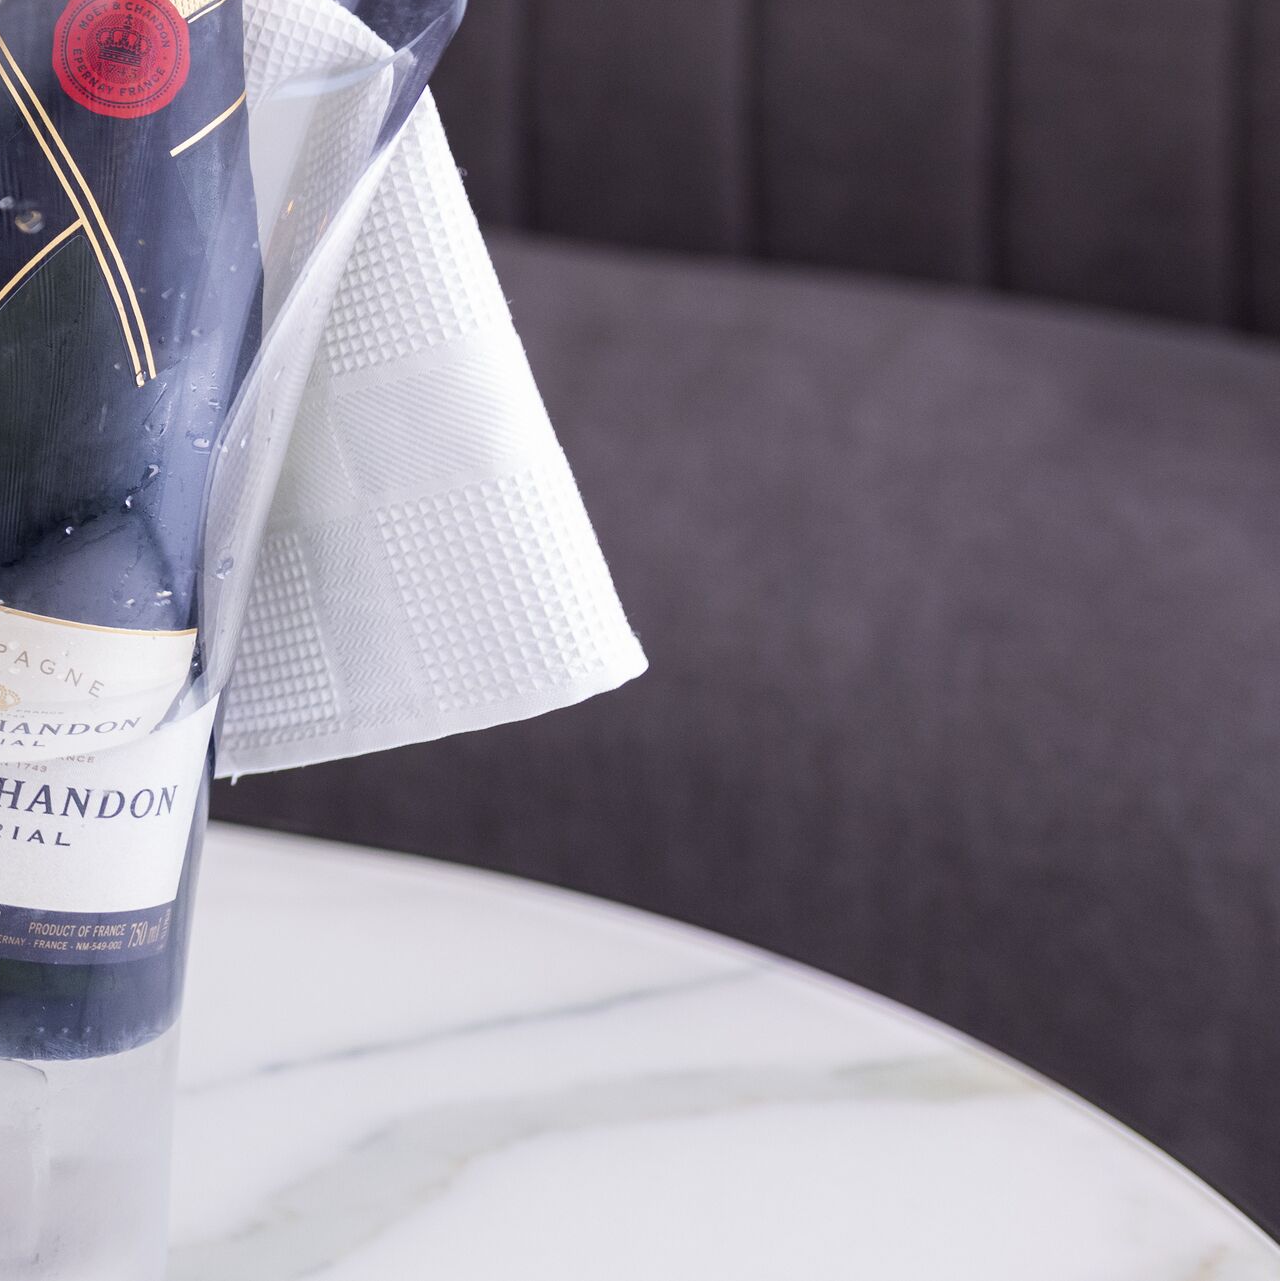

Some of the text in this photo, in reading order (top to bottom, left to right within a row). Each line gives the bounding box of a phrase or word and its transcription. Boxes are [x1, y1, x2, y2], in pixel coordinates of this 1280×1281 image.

[124, 1, 171, 49] CHANDON
[120, 66, 166, 96] FRANCE
[28, 921, 128, 938] PRODUCT OF FRANCE
[127, 922, 149, 949] 750
[33, 939, 68, 951] FRANCE
